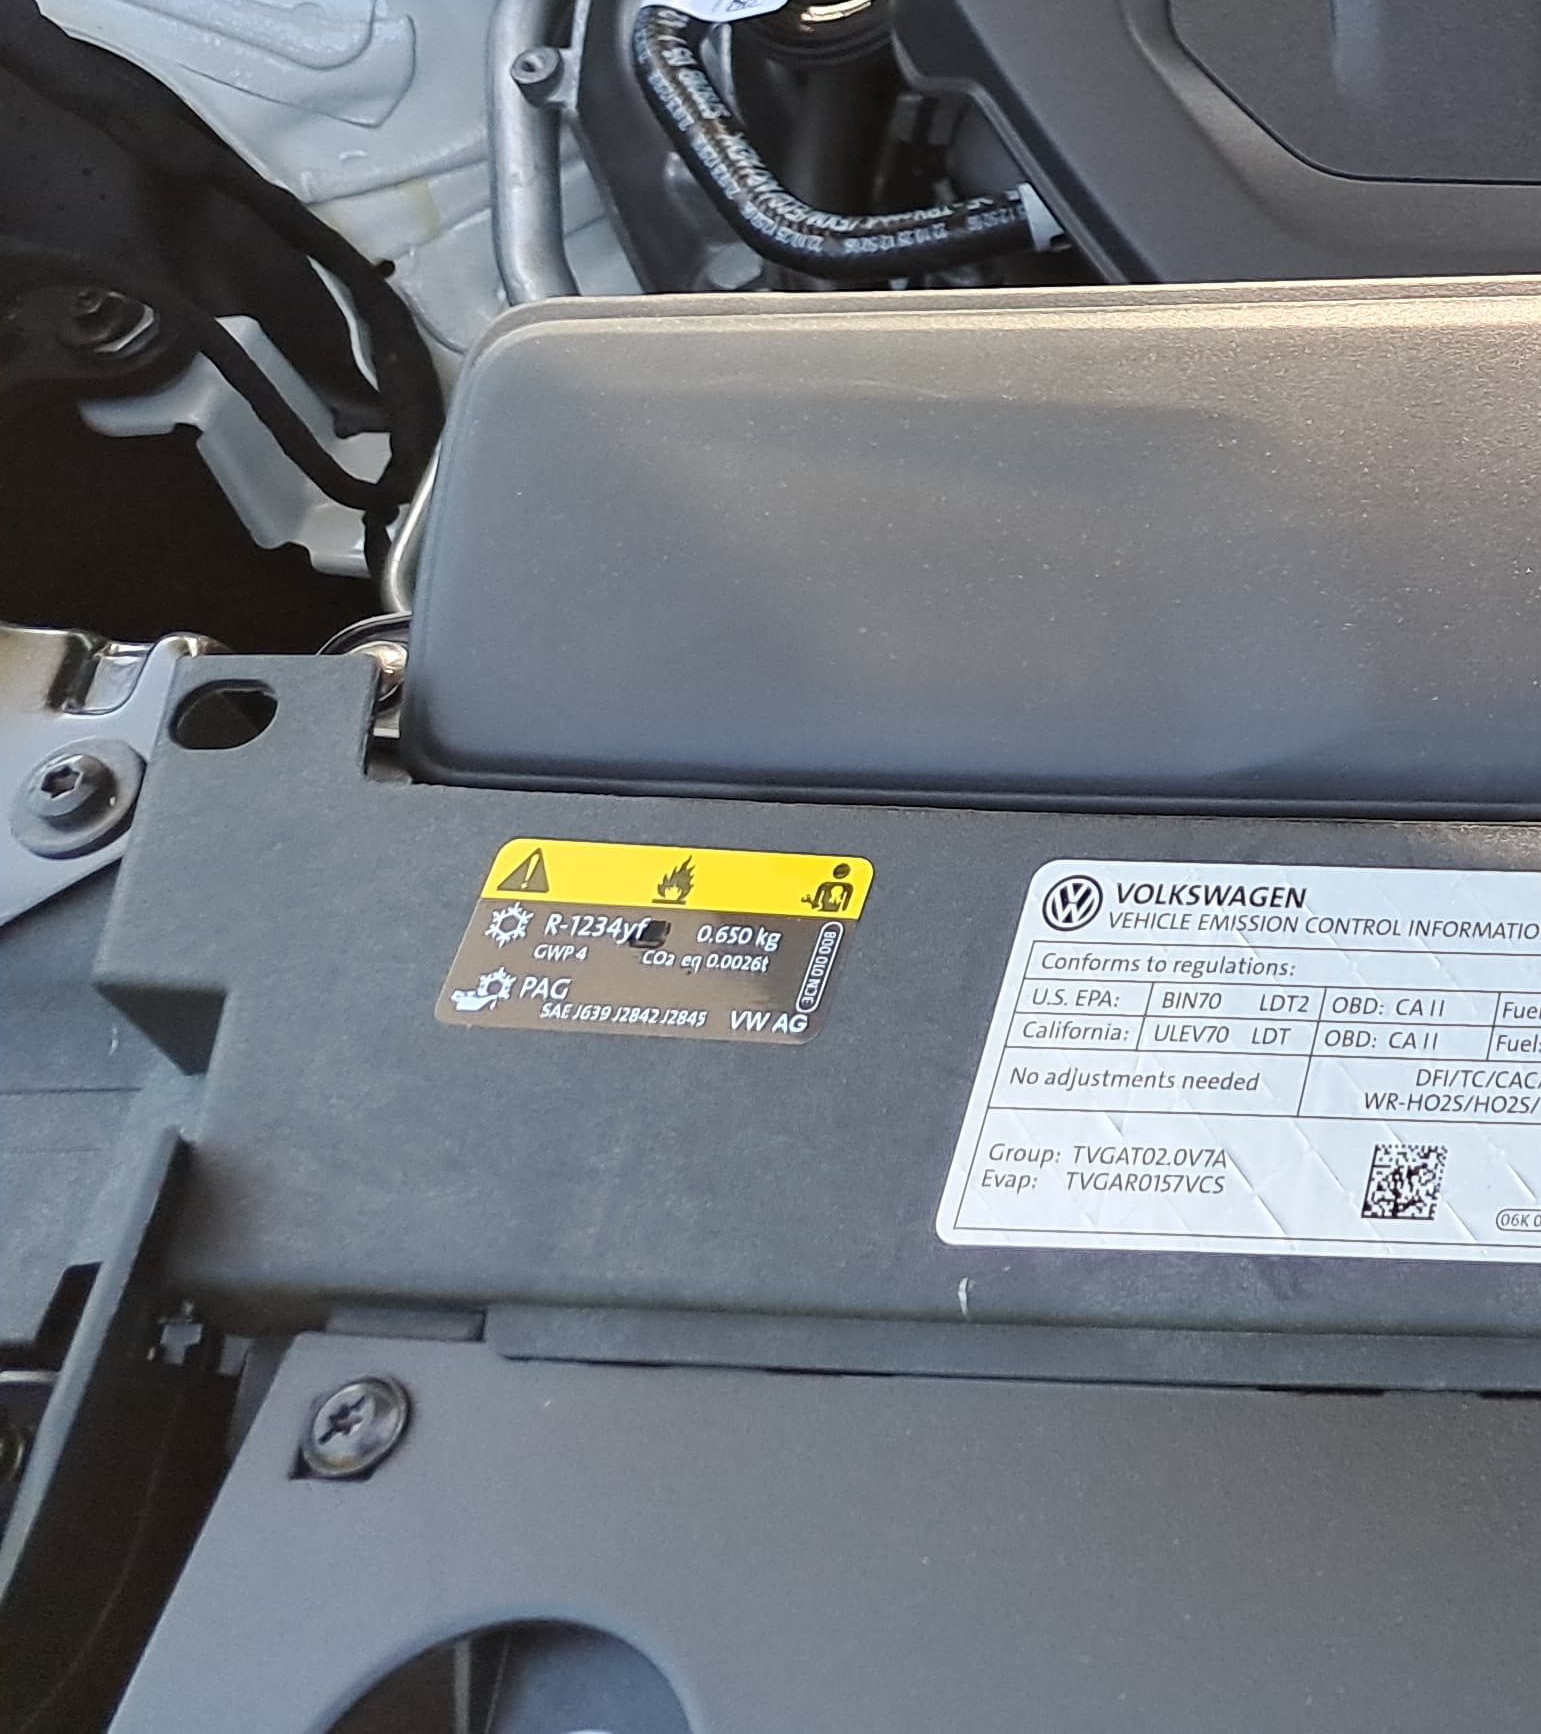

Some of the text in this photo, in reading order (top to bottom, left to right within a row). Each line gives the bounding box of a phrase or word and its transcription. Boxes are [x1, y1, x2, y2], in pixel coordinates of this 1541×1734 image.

[1116, 881, 1307, 909] VOLKSWAGEN
[543, 914, 651, 947] R-1234yf
[1108, 910, 1193, 931] VEHICLE
[1196, 912, 1299, 933] EMISSION
[1304, 915, 1401, 936] CONTROL
[695, 923, 782, 952] 0.650 kg
[1040, 951, 1296, 978] Conforms to regulations:
[518, 975, 574, 1000] PAG
[1031, 986, 1120, 1008] U.S. EPA:
[1160, 990, 1310, 1013] BIN70 LDT2
[1331, 995, 1445, 1018] OBD: CA II
[538, 1000, 708, 1030] SAE J639 J2842 J2845
[730, 1009, 808, 1035] VW AG
[1021, 1019, 1130, 1041] California:
[1153, 1022, 1292, 1046] ULEV70 LDT
[1323, 1028, 1439, 1051] OBD: CA II
[1008, 1065, 1261, 1092] No adjustments needed
[987, 1142, 1231, 1169] Group: TVGAT02.0V7A
[980, 1167, 1226, 1195] Evap: TVGAR0157VCS
